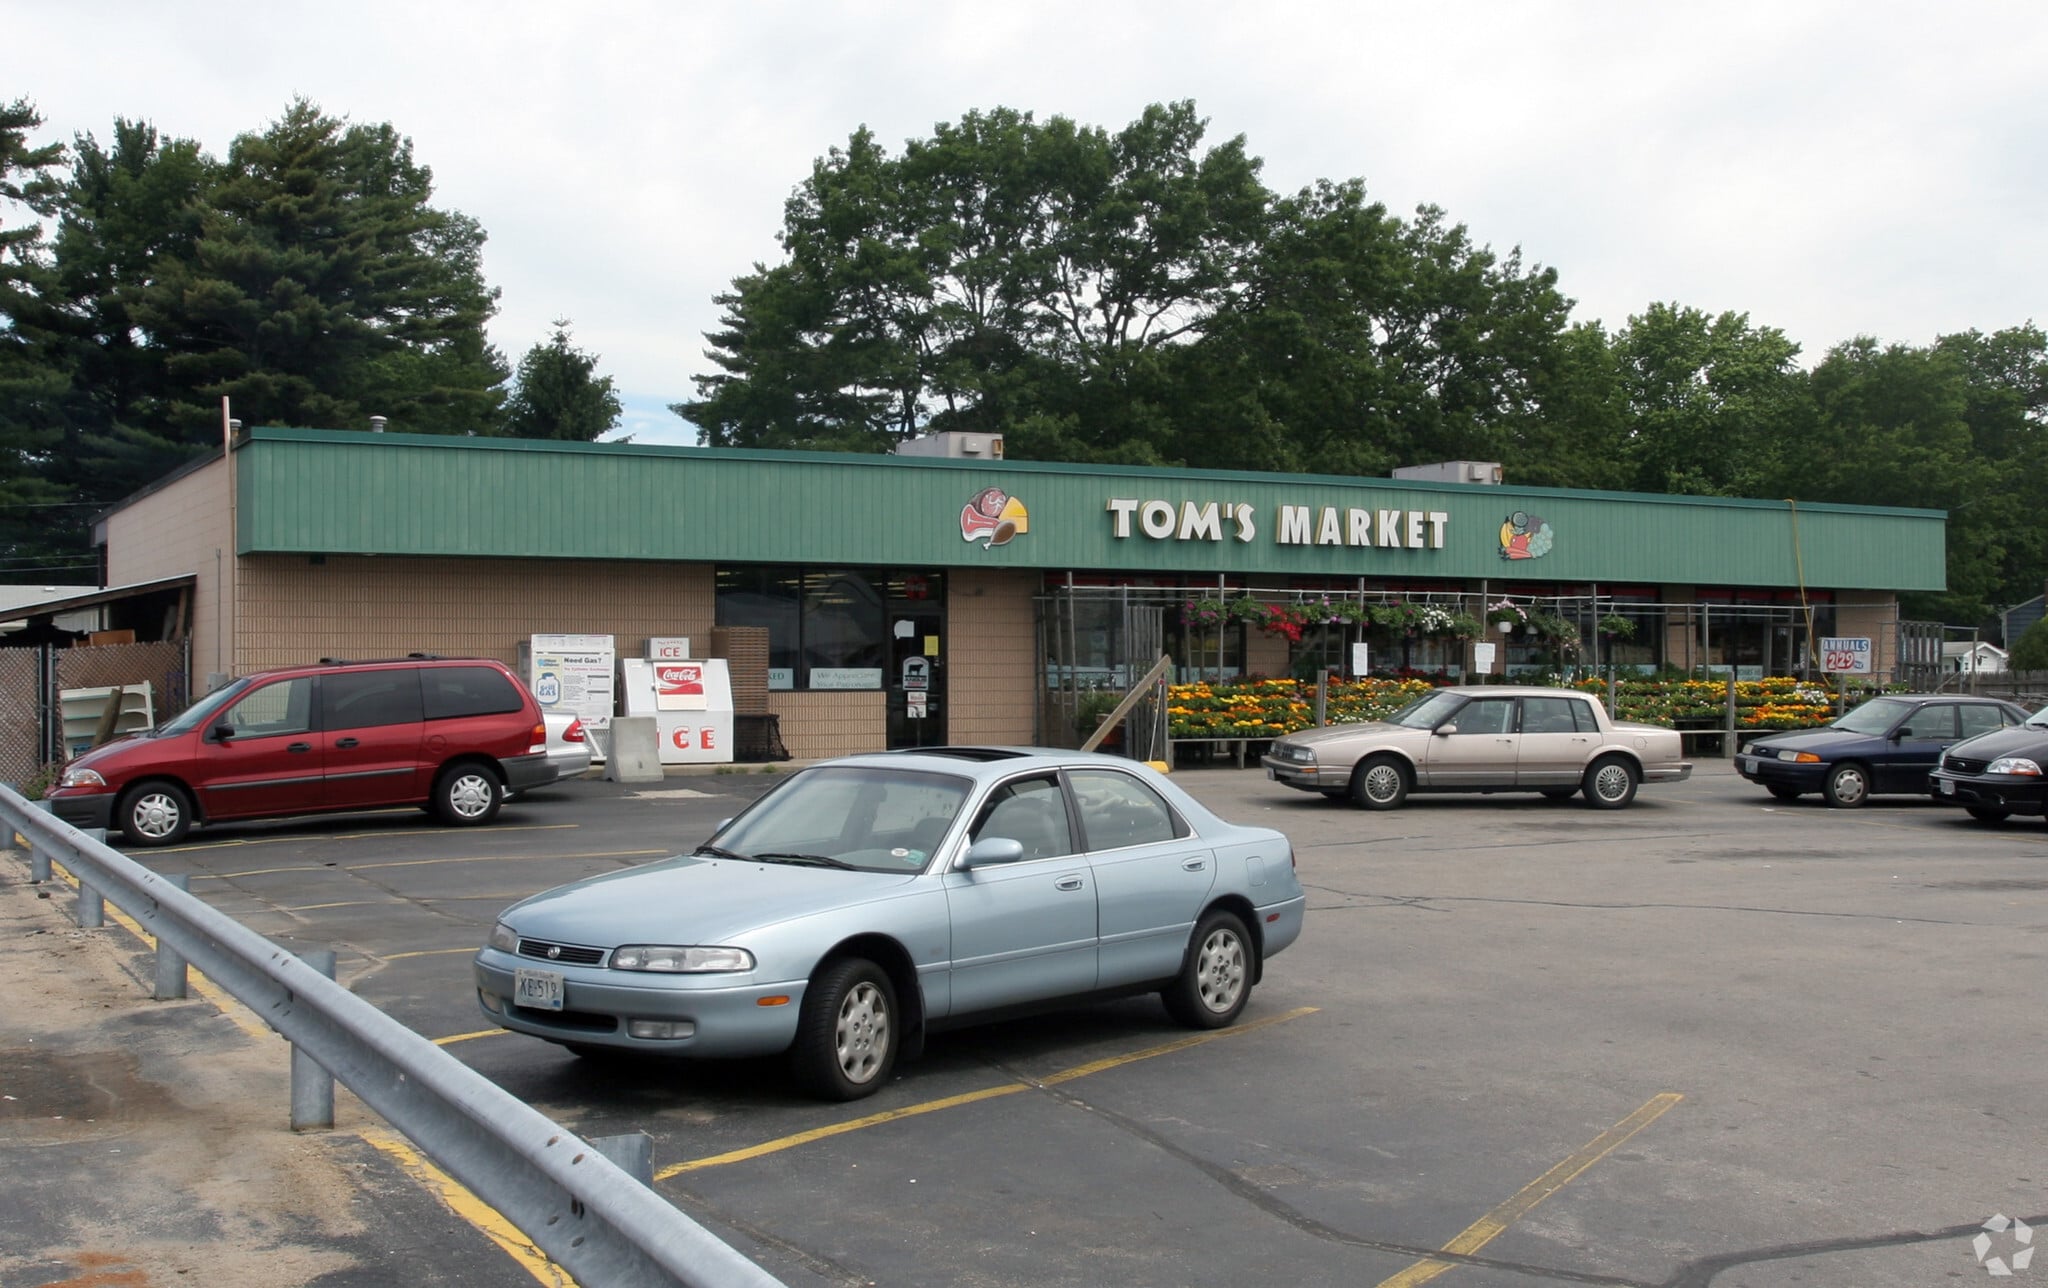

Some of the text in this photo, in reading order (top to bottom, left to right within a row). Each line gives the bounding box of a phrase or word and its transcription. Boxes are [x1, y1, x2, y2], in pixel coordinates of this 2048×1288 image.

[1106, 499, 1448, 549] TOM'S MARKET
[1824, 640, 1867, 651] ANNUALS
[660, 647, 680, 657] ICE
